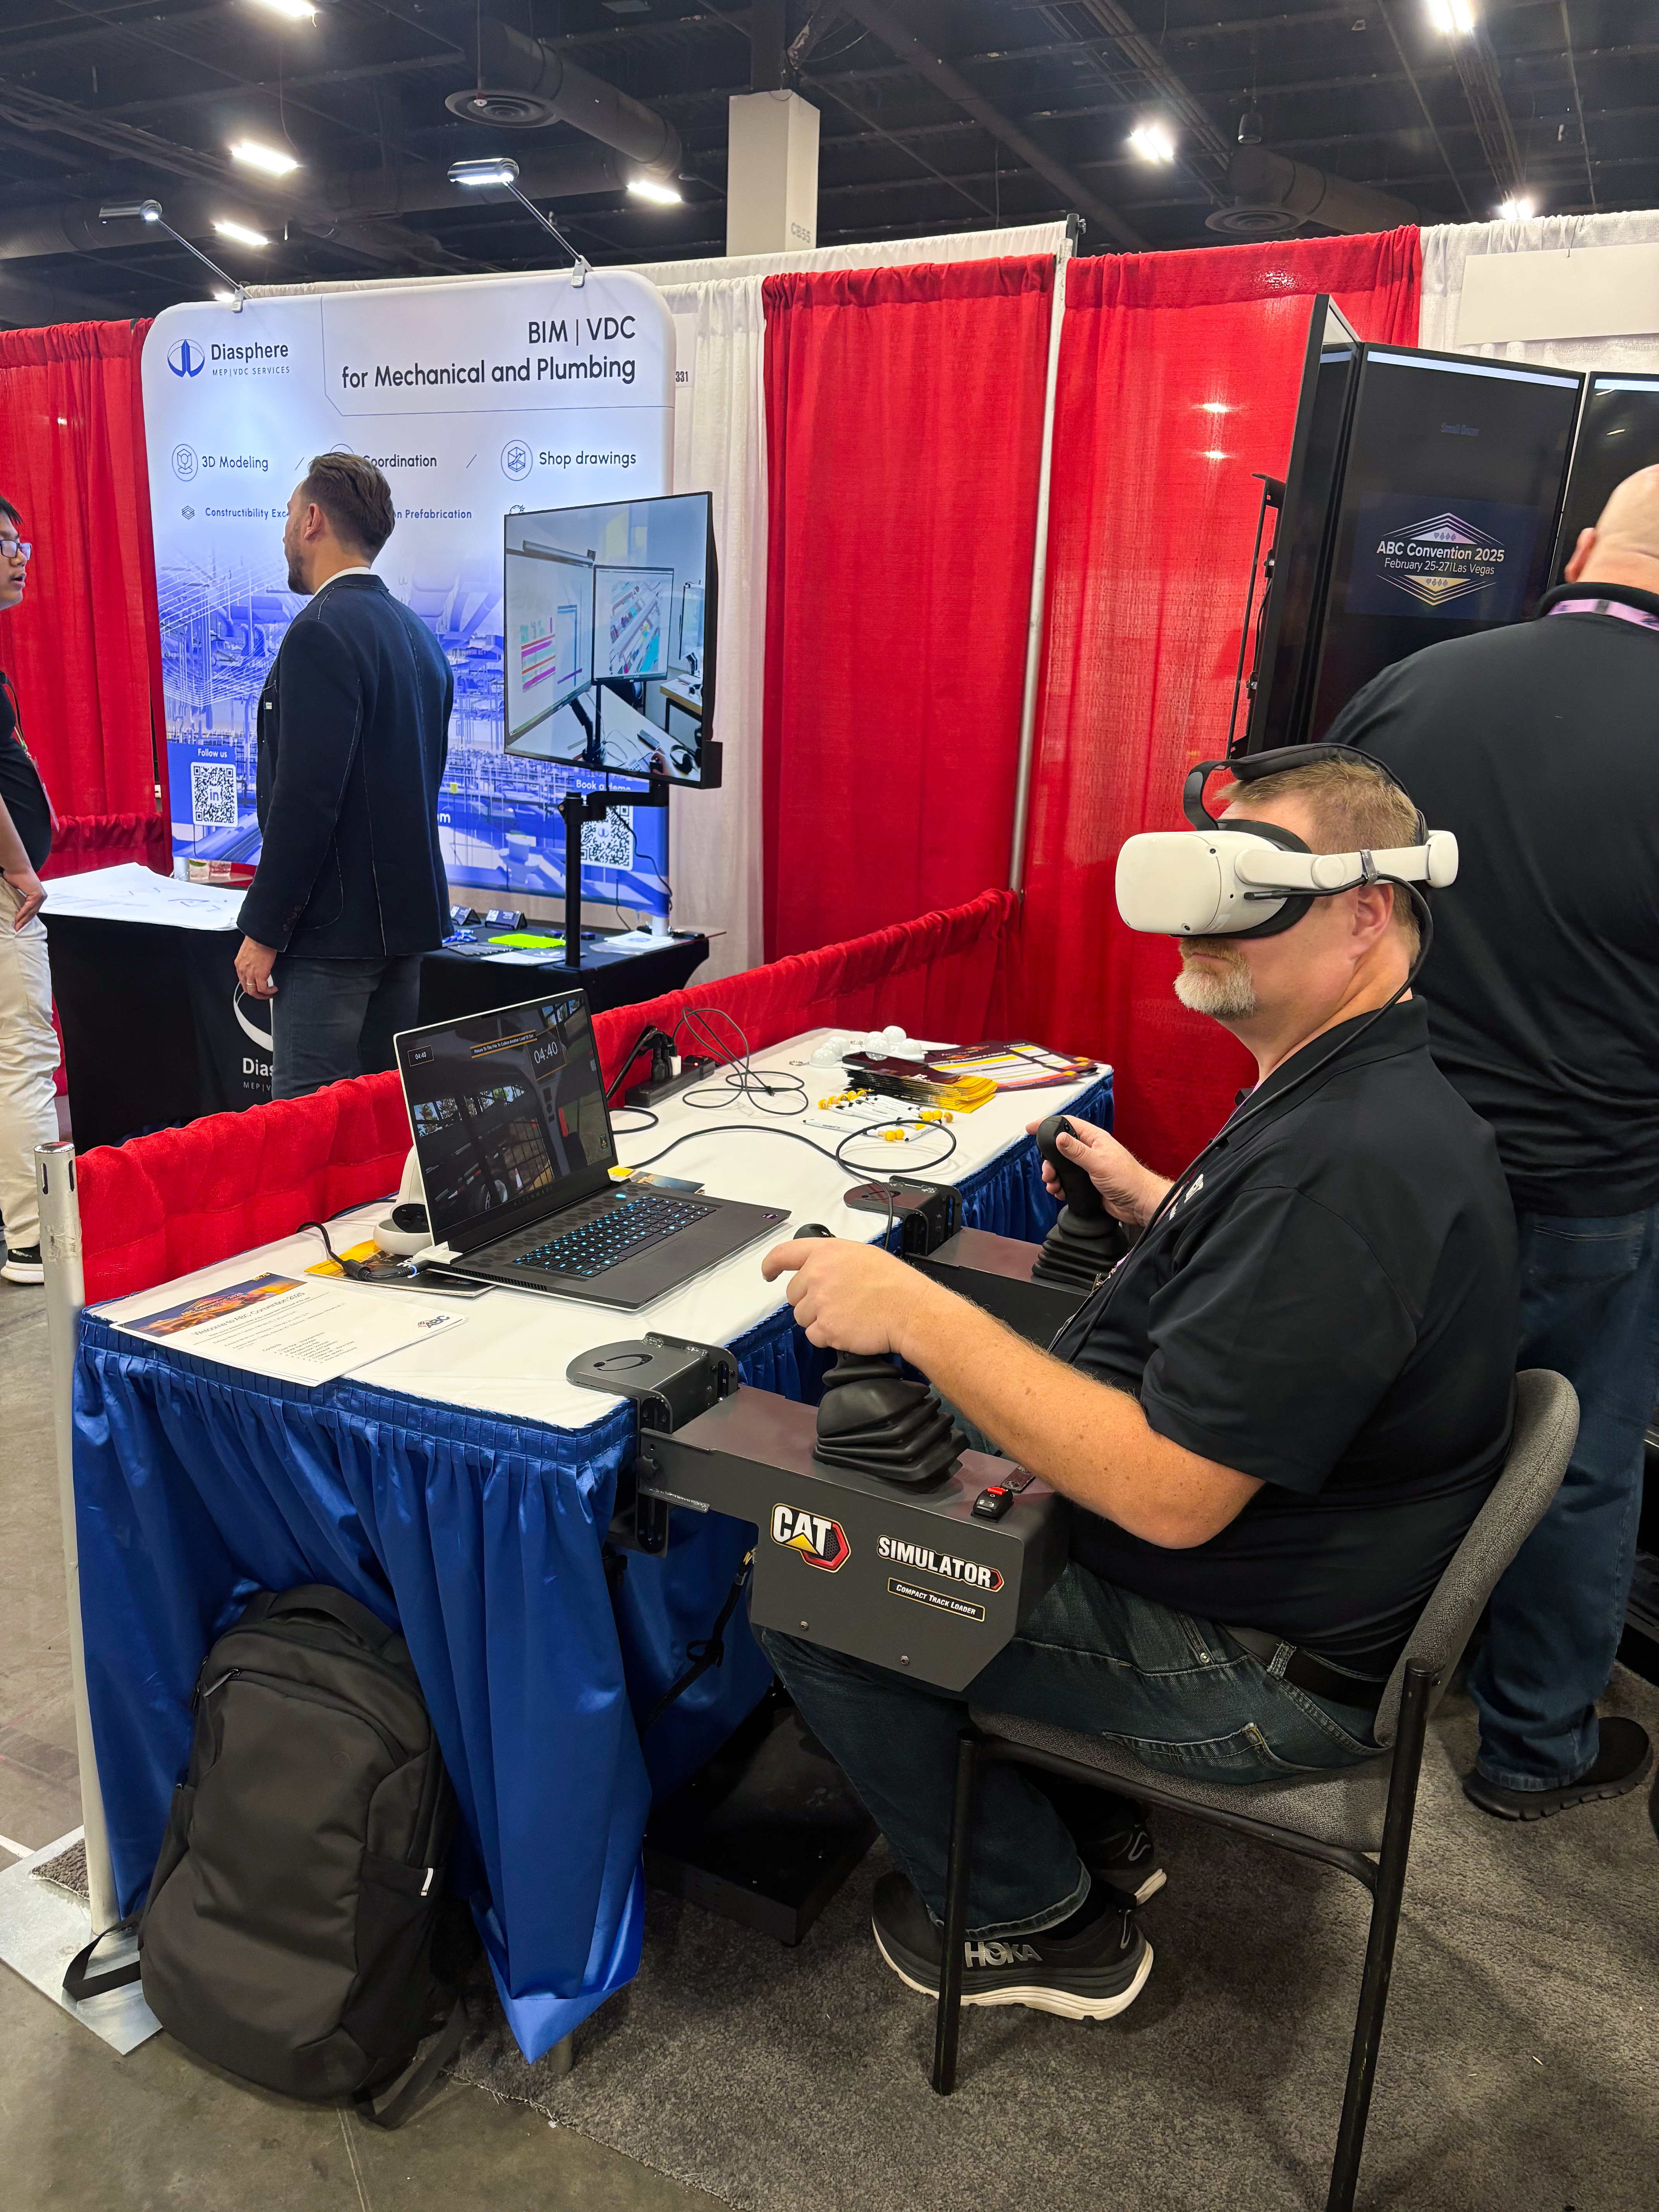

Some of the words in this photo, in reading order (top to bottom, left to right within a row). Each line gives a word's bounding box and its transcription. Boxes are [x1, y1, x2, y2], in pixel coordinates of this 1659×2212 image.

[528, 321, 568, 344] BIM
[586, 315, 636, 340] VDC
[211, 342, 289, 363] Diasphere
[252, 366, 290, 375] SERVICES
[342, 366, 368, 388] for
[374, 359, 485, 387] Mechanical
[491, 357, 530, 382] and
[537, 354, 636, 384] Plumbing
[202, 455, 215, 468] 3D
[220, 455, 268, 472] Modeling
[539, 452, 571, 469] Shop
[575, 451, 637, 468] drawings
[205, 507, 269, 520] Constructibility
[405, 509, 472, 519] Prefabrication
[1376, 541, 1404, 555] ABC
[1407, 543, 1472, 560] Convention
[1474, 548, 1505, 562] 2025
[1384, 558, 1423, 572] February
[1470, 563, 1494, 576] Vegas
[198, 748, 218, 757] Follow
[576, 779, 596, 790] Book
[534, 1041, 558, 1064] 04:40
[191, 1322, 228, 1336] Welcome
[235, 1313, 252, 1321] ABC
[251, 1297, 288, 1316] Convention
[287, 1292, 305, 1300] 2025
[426, 1316, 450, 1328] ABC
[773, 1506, 832, 1556] CAT
[878, 1536, 991, 1587] SIMULATOR
[964, 1941, 1042, 1968] HOKA
